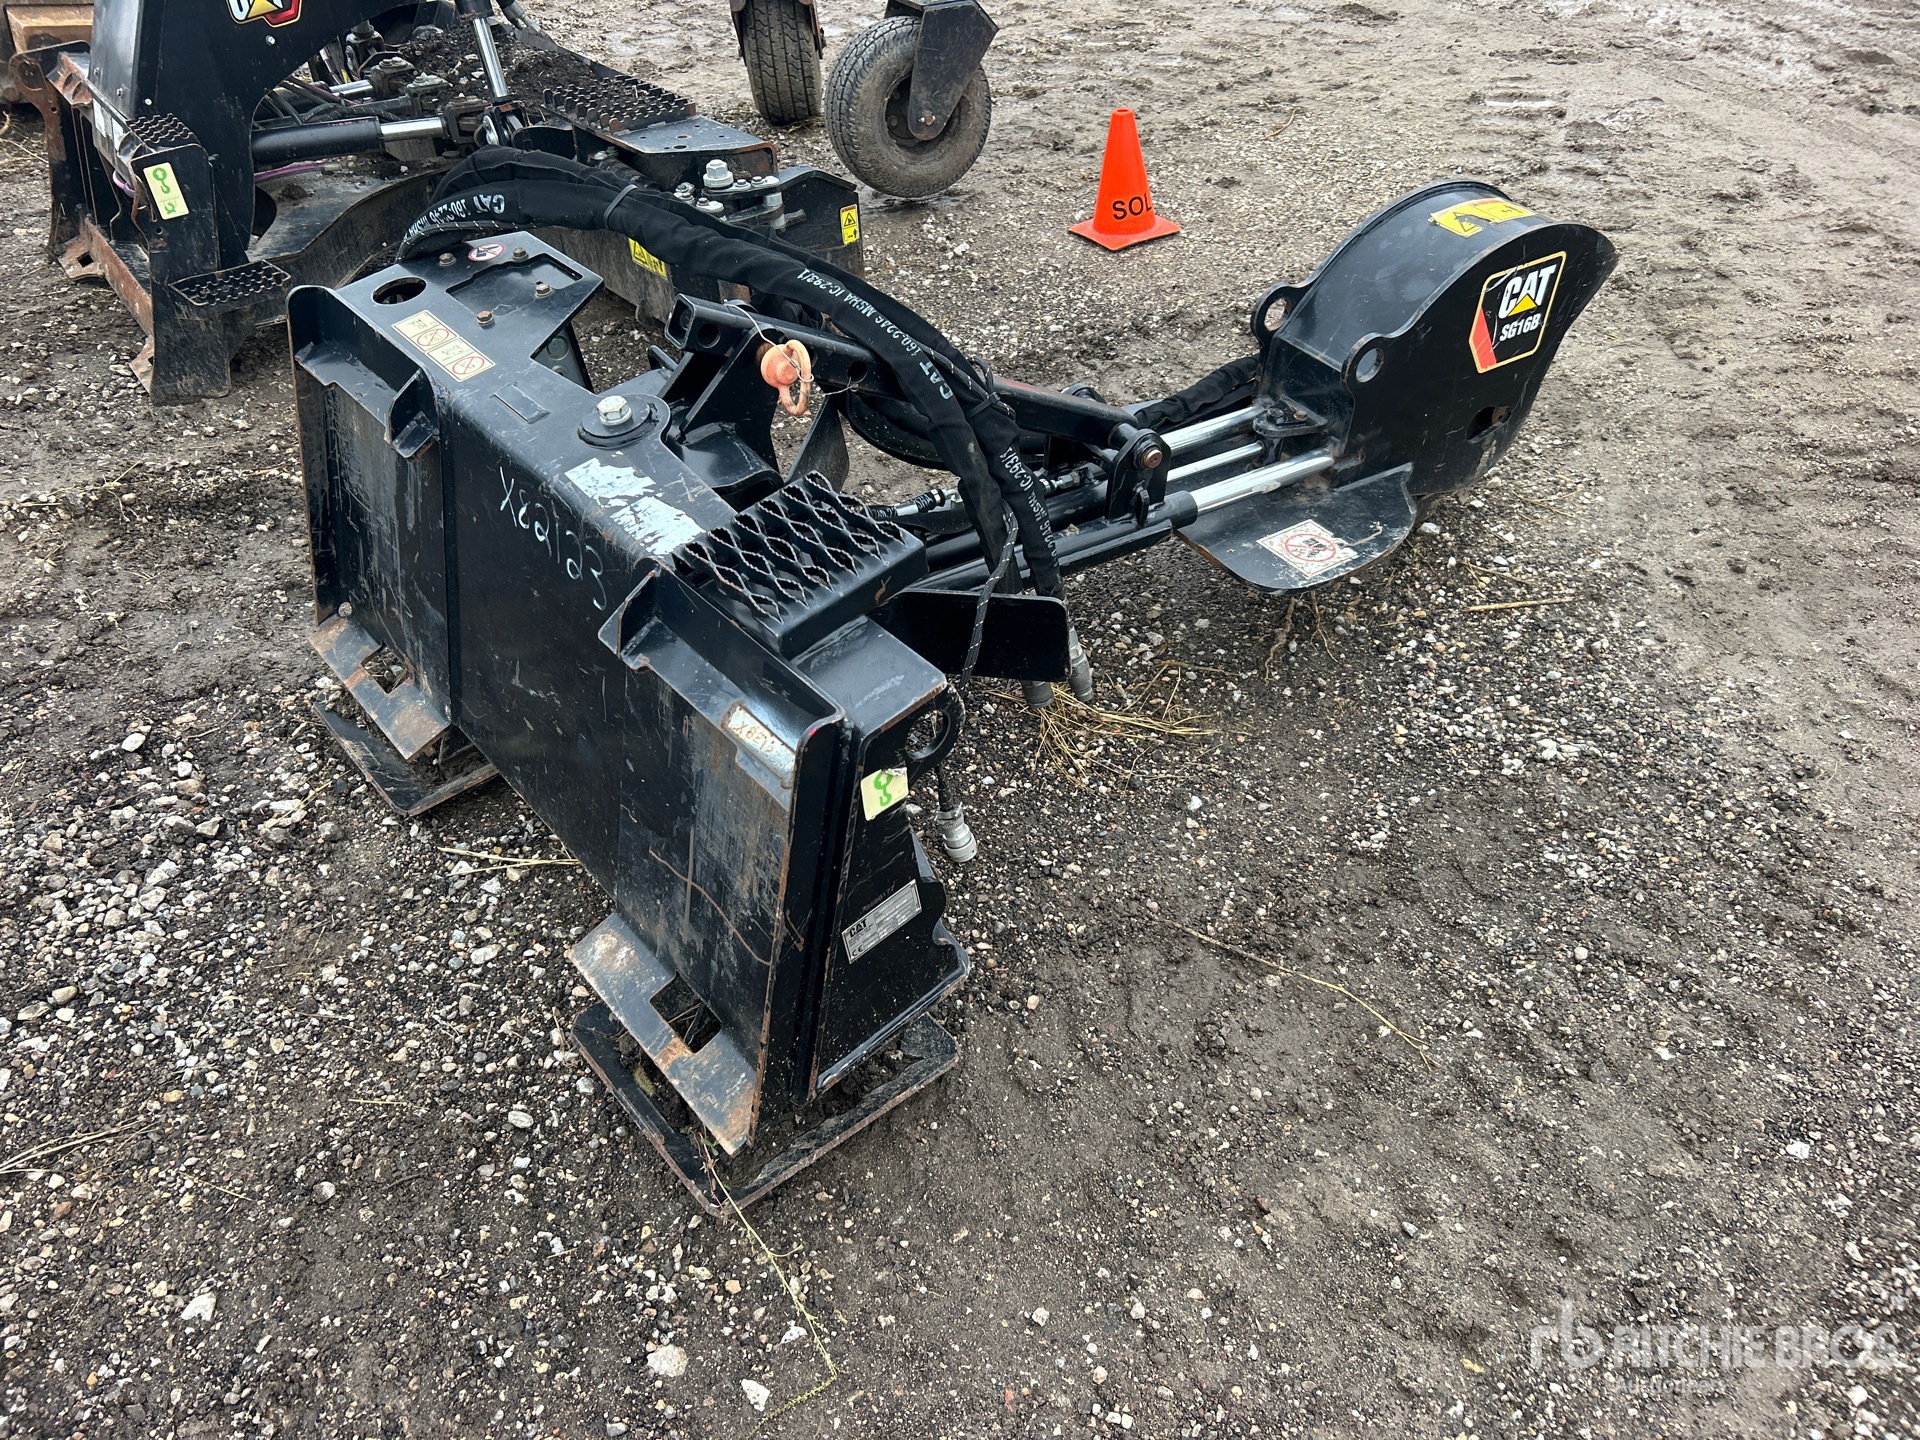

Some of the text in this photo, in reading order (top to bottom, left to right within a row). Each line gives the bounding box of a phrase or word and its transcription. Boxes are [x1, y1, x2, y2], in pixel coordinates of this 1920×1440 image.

[473, 194, 505, 214] CAT
[1499, 264, 1557, 319] CAT
[1500, 313, 1542, 342] SG16B
[919, 361, 954, 400] CAT
[849, 918, 868, 938] CAT
